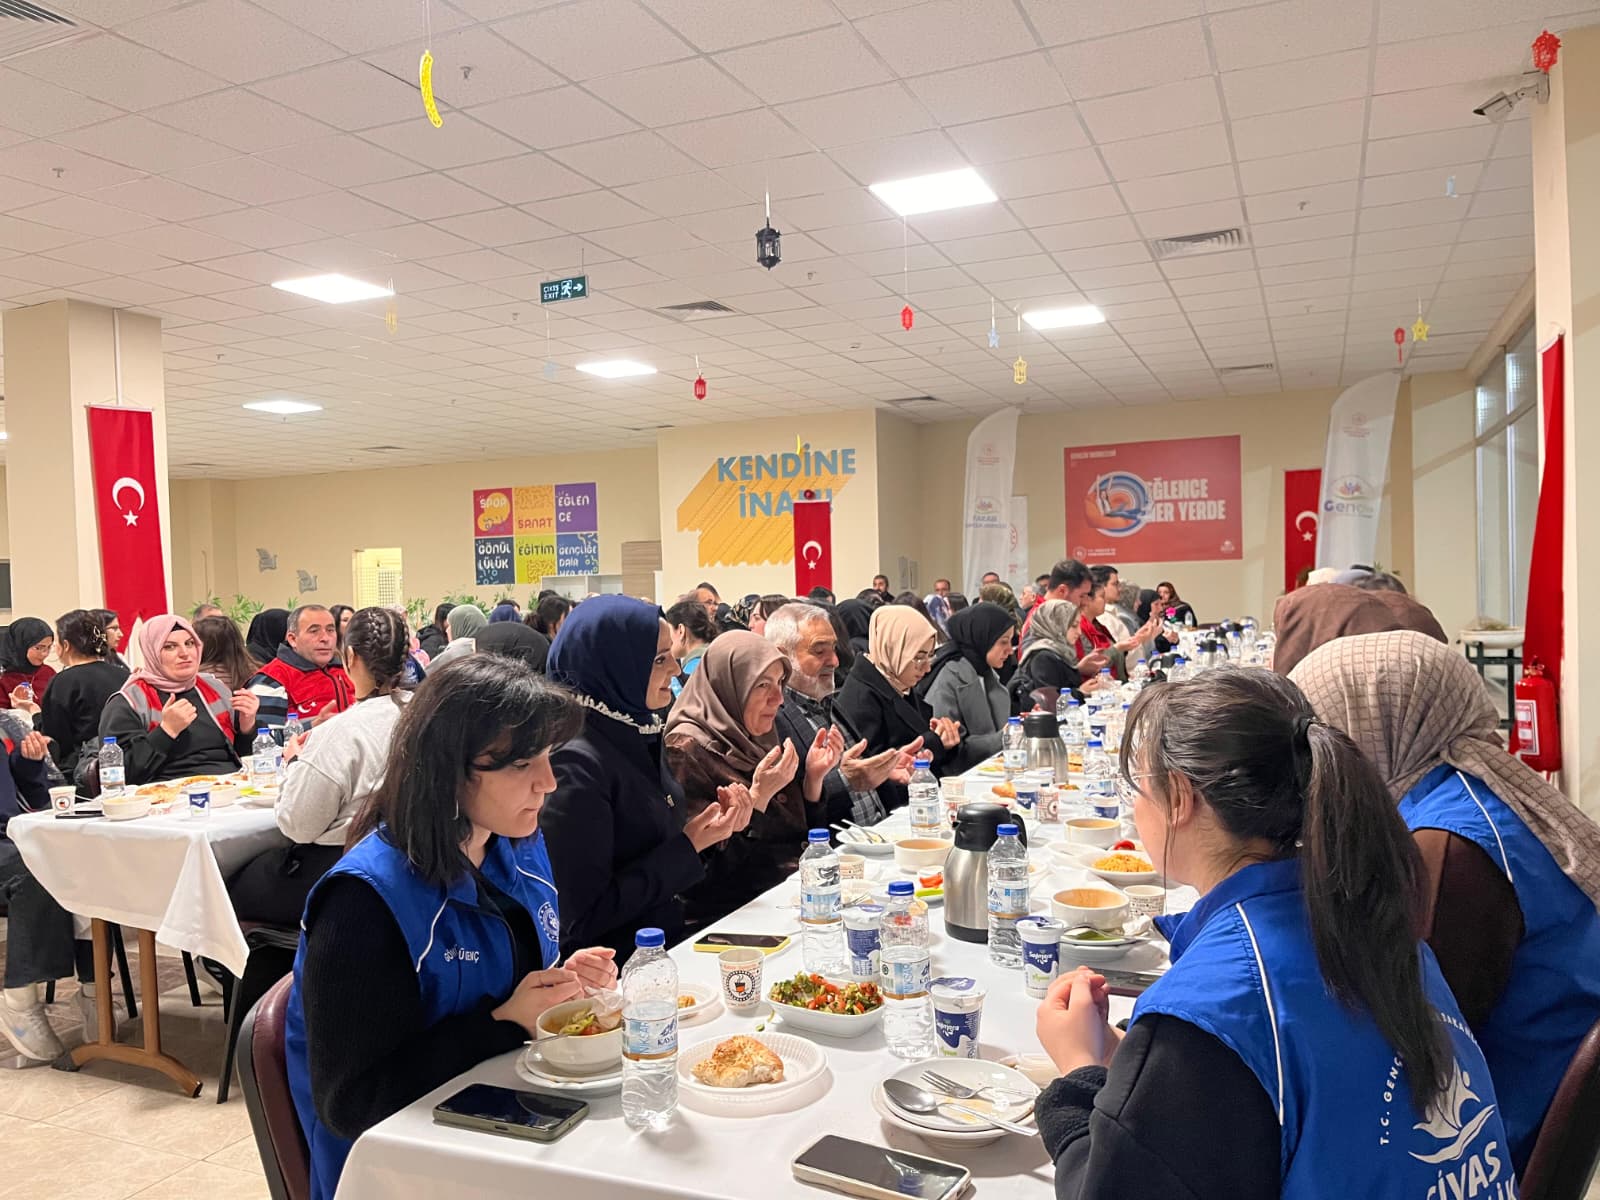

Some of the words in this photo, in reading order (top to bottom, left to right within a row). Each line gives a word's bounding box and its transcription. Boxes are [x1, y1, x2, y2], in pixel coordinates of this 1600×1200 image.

[543, 291, 559, 300] EXIT
[717, 443, 856, 482] KENDİNE
[558, 493, 590, 507] EĞLEN
[1178, 499, 1226, 521] YERDE
[518, 518, 553, 529] SANAT
[478, 540, 511, 555] GÖNÜL
[519, 543, 554, 556] EĞİTİM
[478, 556, 509, 569] LÜLÜK
[1379, 1111, 1390, 1145] T.C.
